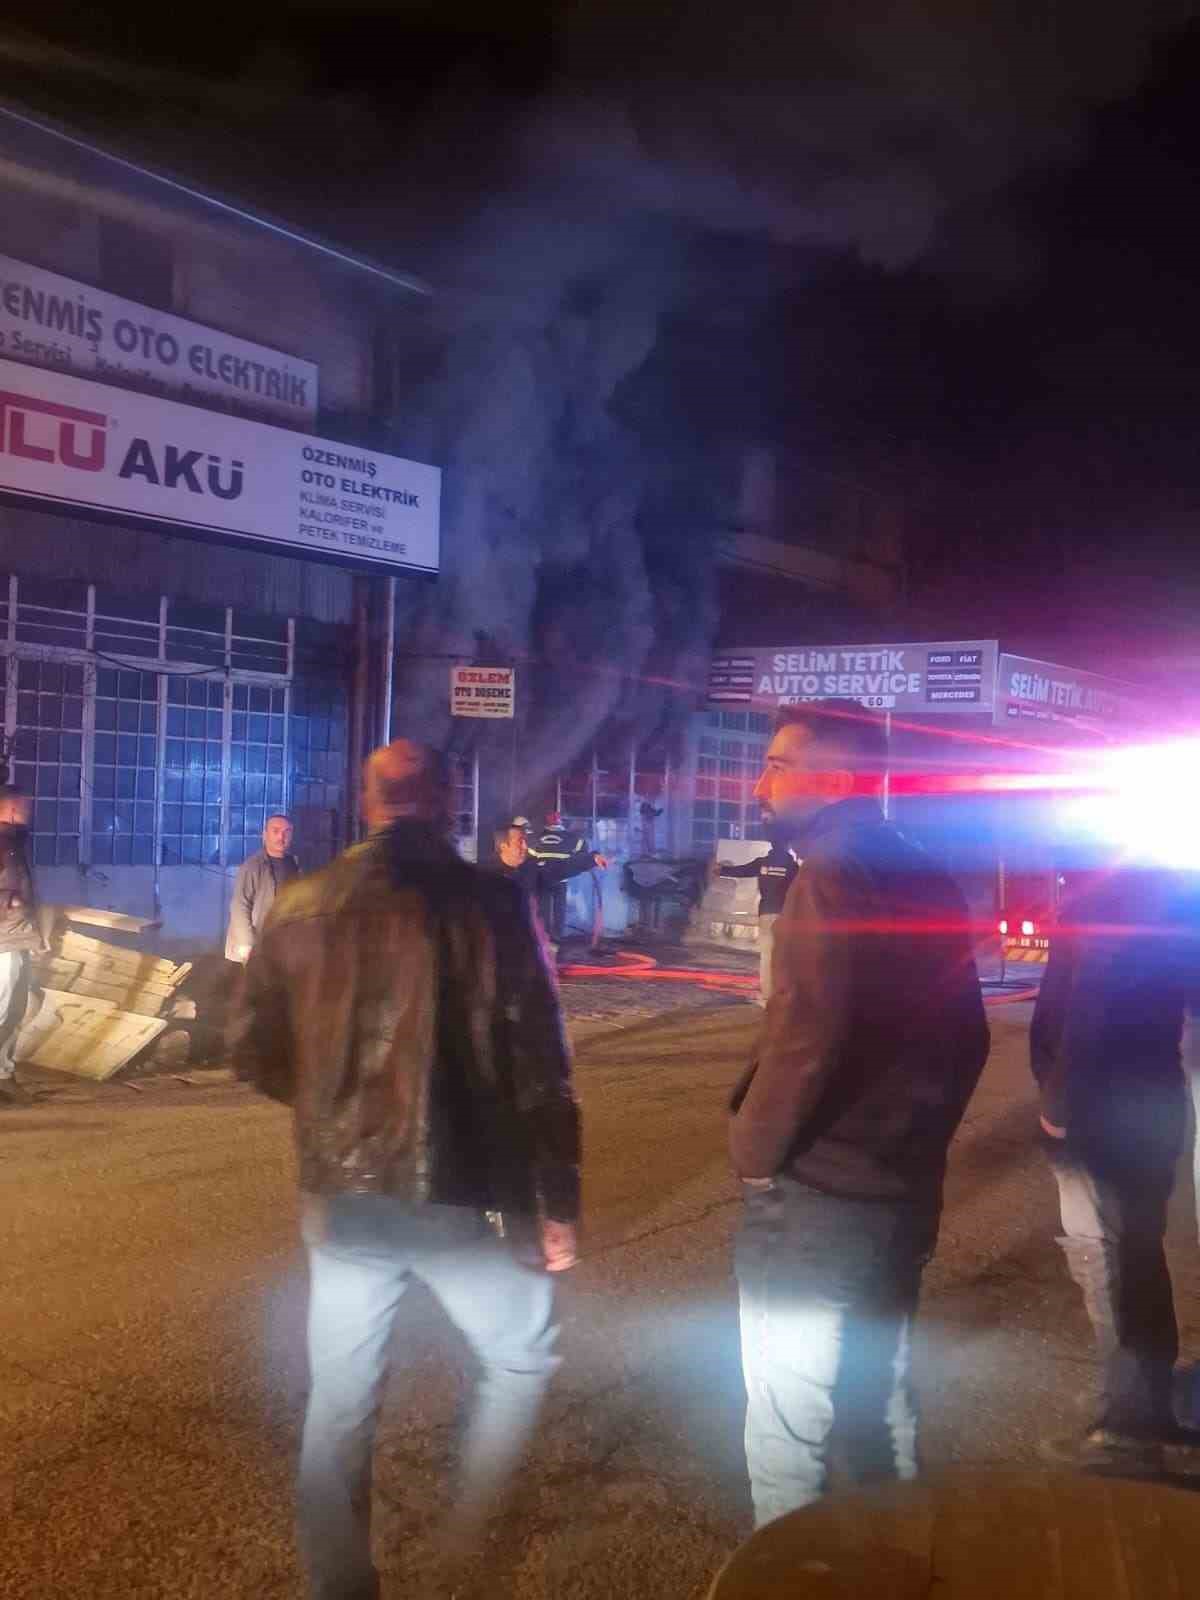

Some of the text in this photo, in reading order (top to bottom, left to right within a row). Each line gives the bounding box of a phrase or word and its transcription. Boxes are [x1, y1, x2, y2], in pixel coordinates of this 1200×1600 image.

[113, 318, 179, 366] OTO
[188, 344, 307, 406] ELEKTRİK
[118, 438, 244, 500] AKÜ
[301, 445, 377, 479] ÖZENMİŞ
[301, 470, 420, 508] OTO ELEKTRİK
[757, 674, 819, 695] AUTO
